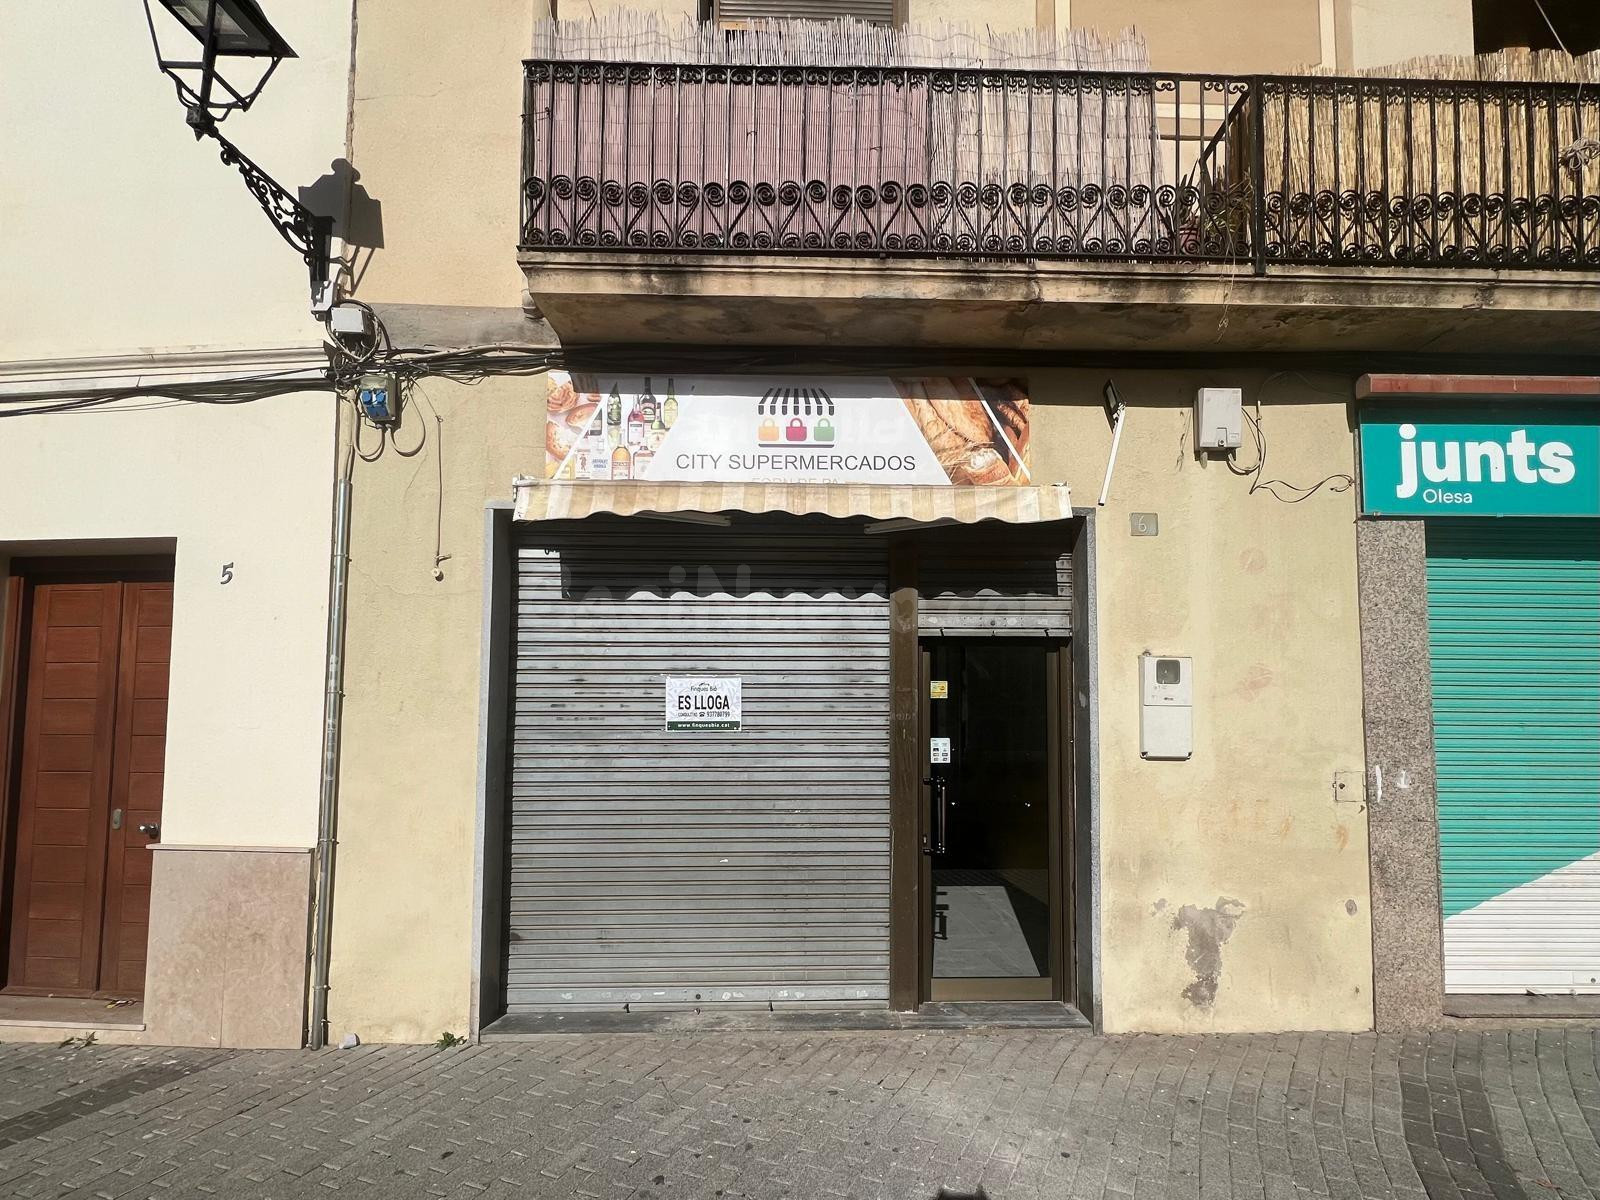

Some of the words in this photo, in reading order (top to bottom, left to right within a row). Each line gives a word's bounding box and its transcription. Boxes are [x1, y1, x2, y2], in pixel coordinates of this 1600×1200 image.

[676, 454, 723, 471] CITY
[728, 454, 916, 472] SUPERMERCADOS
[1396, 424, 1576, 499] junts
[1422, 489, 1473, 504] Olesa
[1138, 514, 1148, 533] 6
[220, 562, 233, 585] 5
[678, 695, 691, 710] ES
[695, 695, 730, 710] LLOGA
